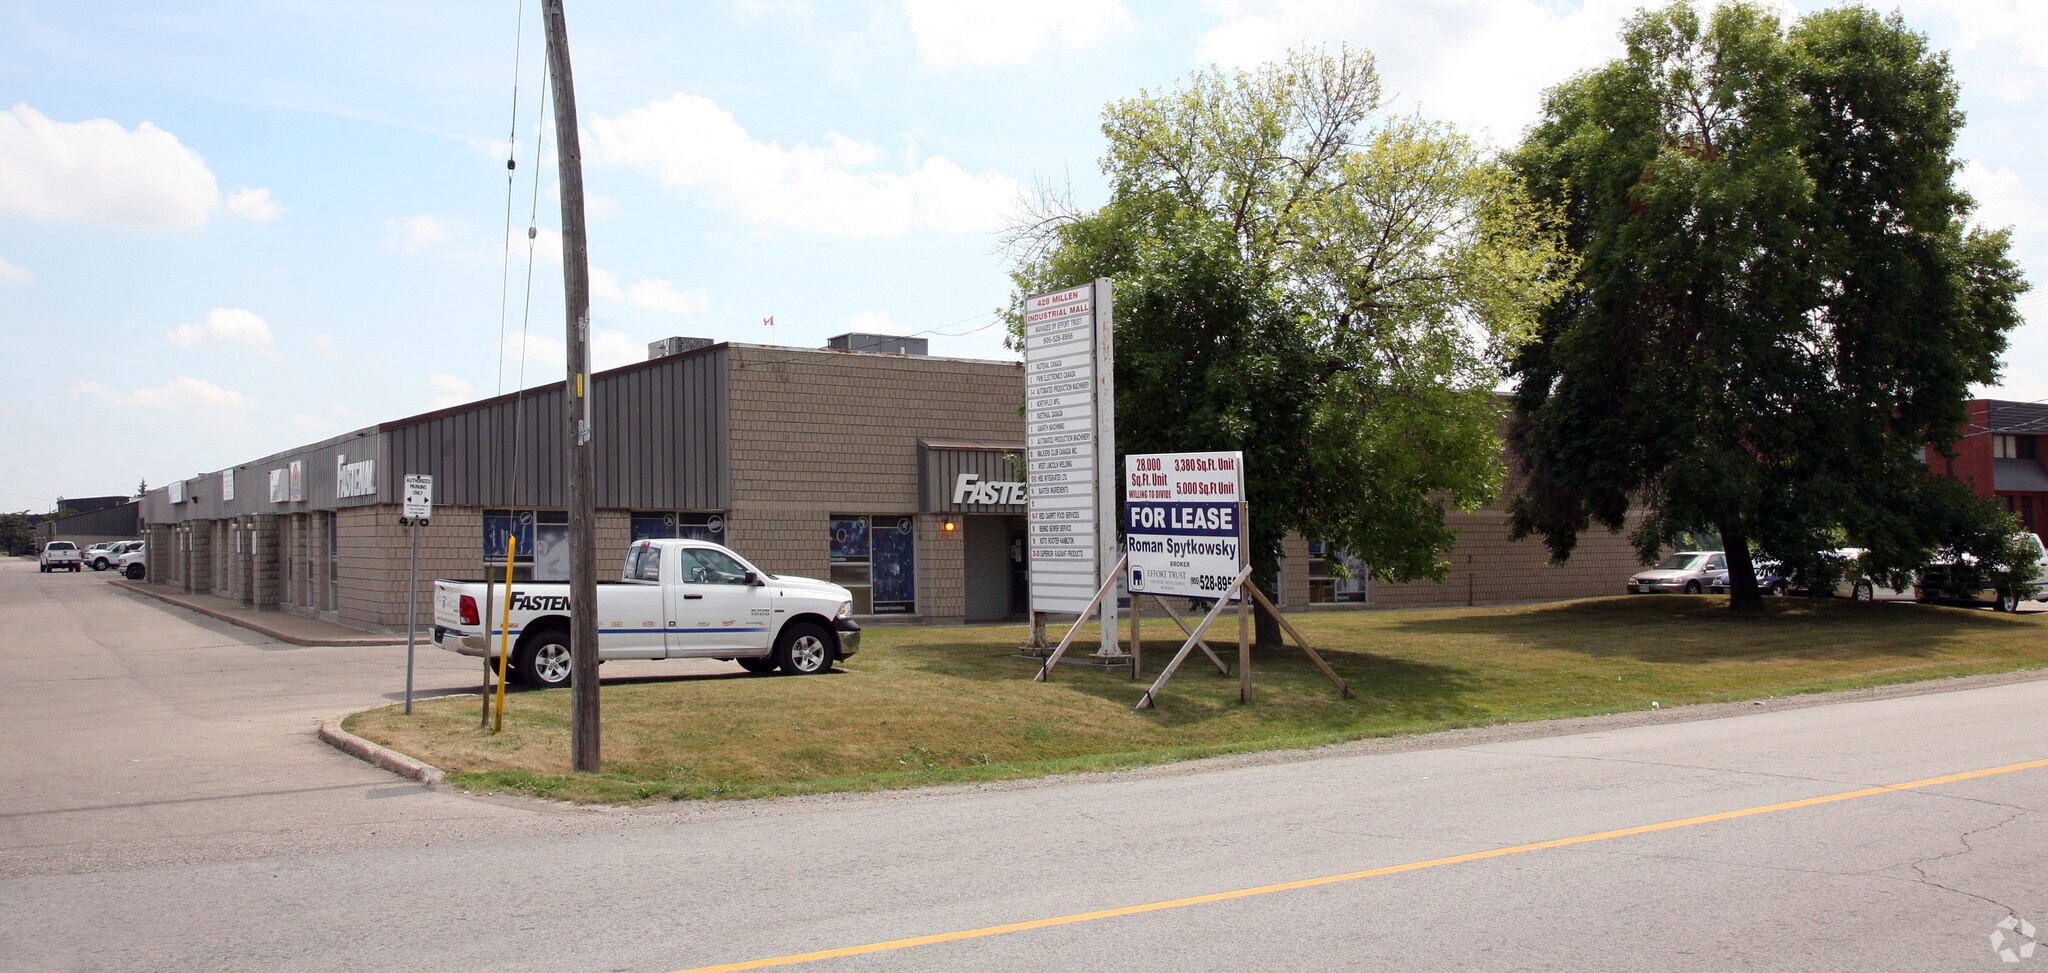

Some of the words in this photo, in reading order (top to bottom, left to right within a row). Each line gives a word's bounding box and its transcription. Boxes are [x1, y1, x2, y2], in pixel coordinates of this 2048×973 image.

[1037, 297, 1049, 306] 428
[1052, 291, 1078, 304] MILLEN
[1028, 308, 1067, 322] INDUSTRIAL
[1070, 303, 1088, 315] MALL
[1035, 324, 1051, 333] MANAGED
[1052, 322, 1056, 330] BY
[1057, 321, 1070, 329] EFFORT
[1071, 318, 1081, 327] TRUST
[1051, 360, 1062, 368] CANADA
[1064, 371, 1076, 379] CANADA
[1037, 386, 1053, 395] AUTOMATED
[1054, 384, 1072, 393] PRODUCTION
[1073, 382, 1089, 391] MACHINERY
[1051, 409, 1063, 417] CANADA
[1037, 436, 1053, 445] AUTOMATED
[1054, 434, 1073, 443] PRODUCTION
[1074, 432, 1090, 441] MACHINERY
[1137, 458, 1161, 471] 28,000
[1175, 459, 1195, 471] 3,380
[1219, 458, 1234, 470] Unit
[337, 454, 376, 498] FASTENAL
[1132, 473, 1151, 487] Sq.Ft.
[1152, 473, 1167, 486] Unit
[953, 474, 1028, 504] FASTE
[1129, 490, 1148, 499] WILLING
[1149, 490, 1155, 498] TO
[1156, 490, 1171, 498] DIVIDE
[1177, 482, 1197, 495] 5,000
[1219, 482, 1234, 494] Unit
[1131, 507, 1166, 528] FOR
[1171, 508, 1232, 529] LEASE
[1129, 537, 1163, 553] Roman
[1167, 538, 1236, 560] Spytkowsky
[1147, 570, 1167, 578] EFFORT
[1169, 571, 1186, 579] TRUST
